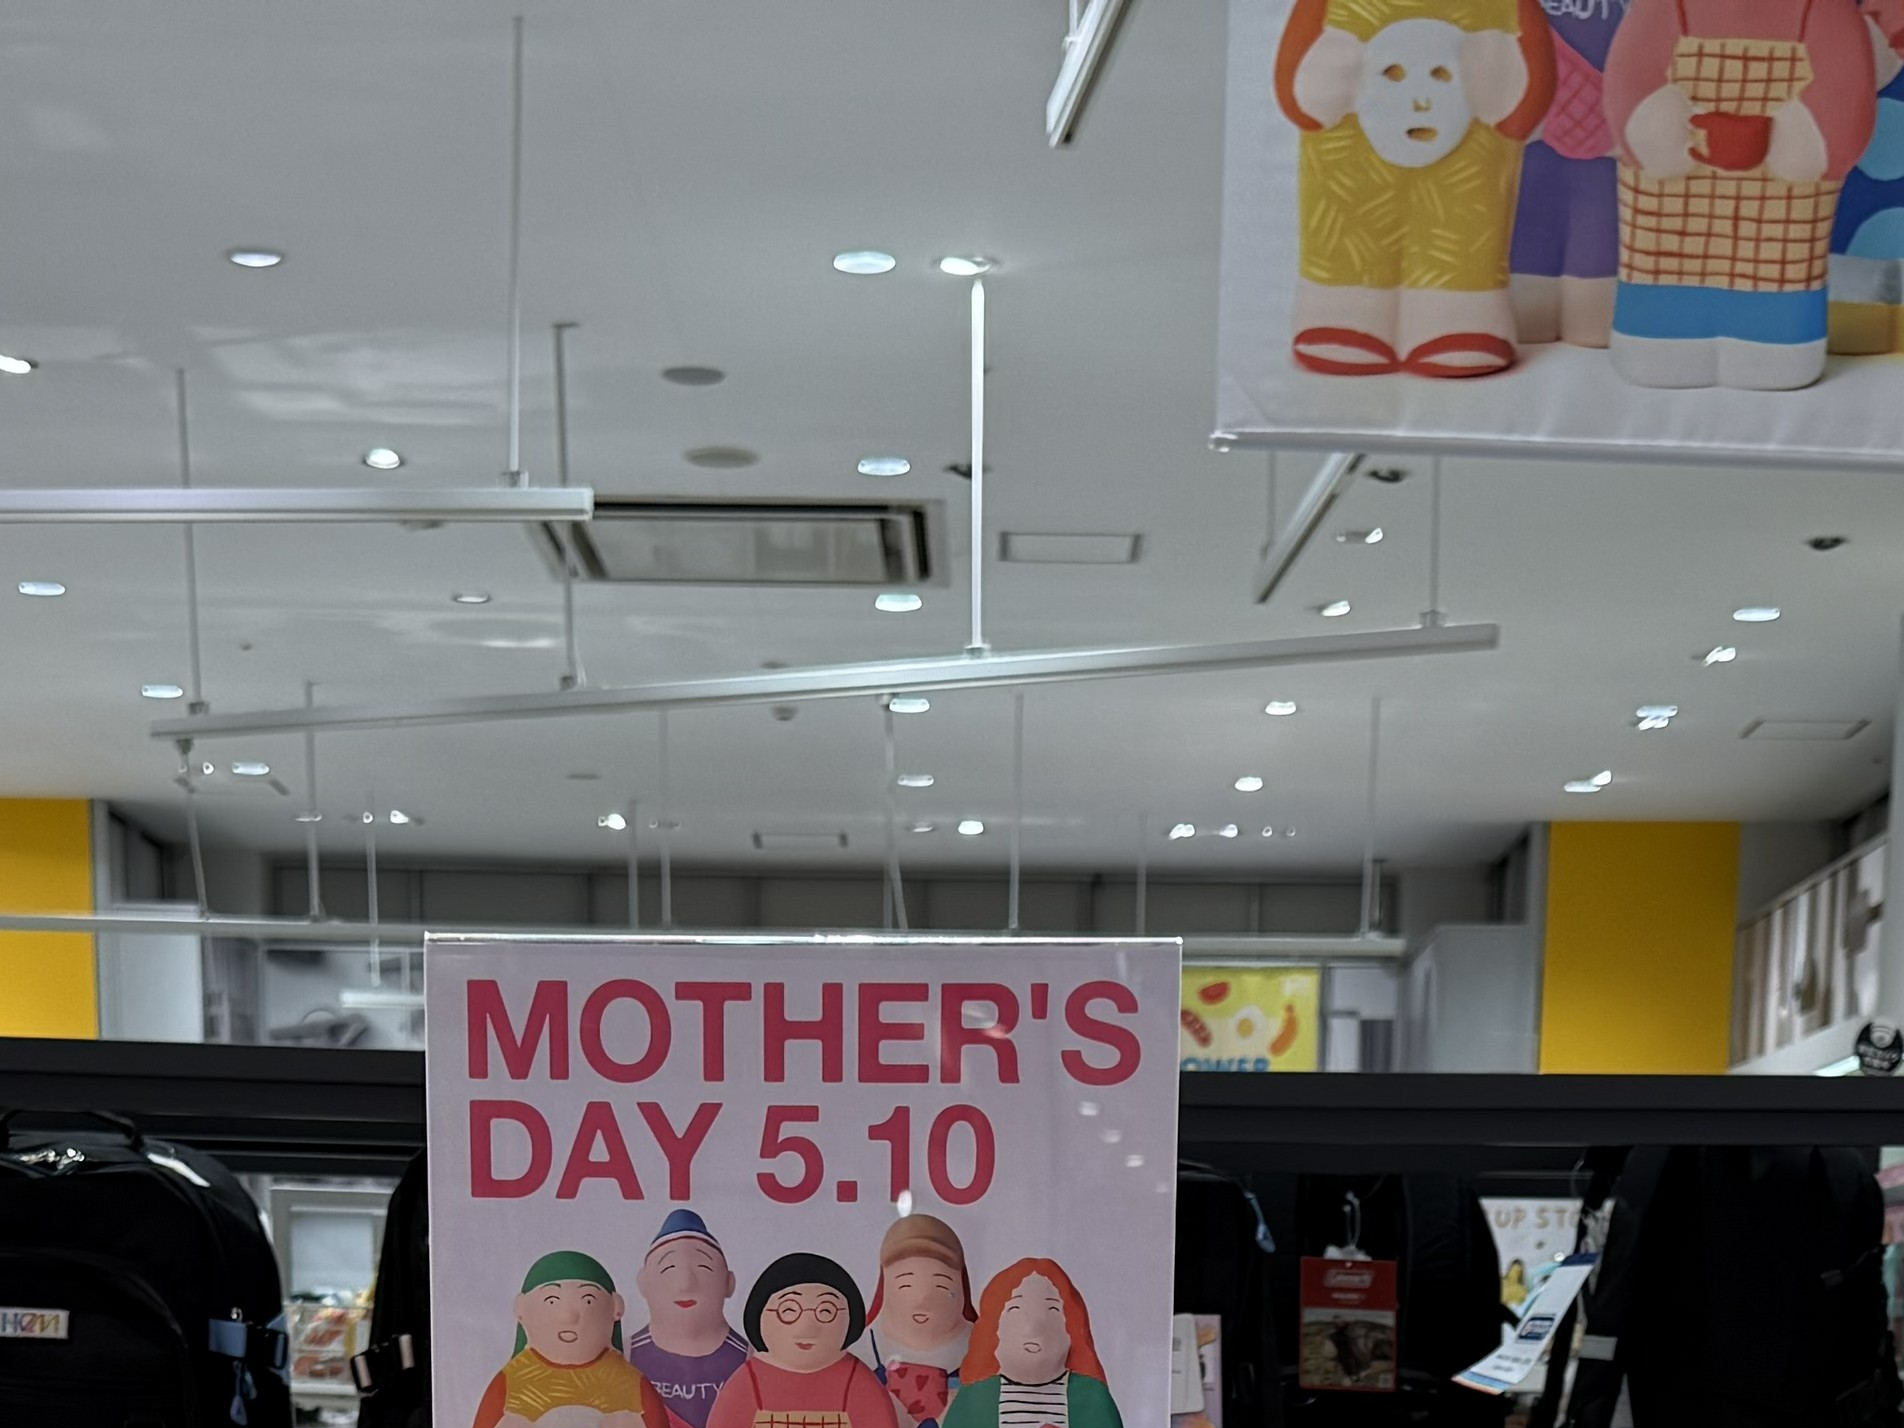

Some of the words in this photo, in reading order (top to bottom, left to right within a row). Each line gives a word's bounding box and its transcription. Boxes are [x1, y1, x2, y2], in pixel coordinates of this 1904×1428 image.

[466, 978, 1143, 1087] MOTHER'S
[470, 1101, 724, 1201] DAY
[756, 1104, 998, 1206] 5.10
